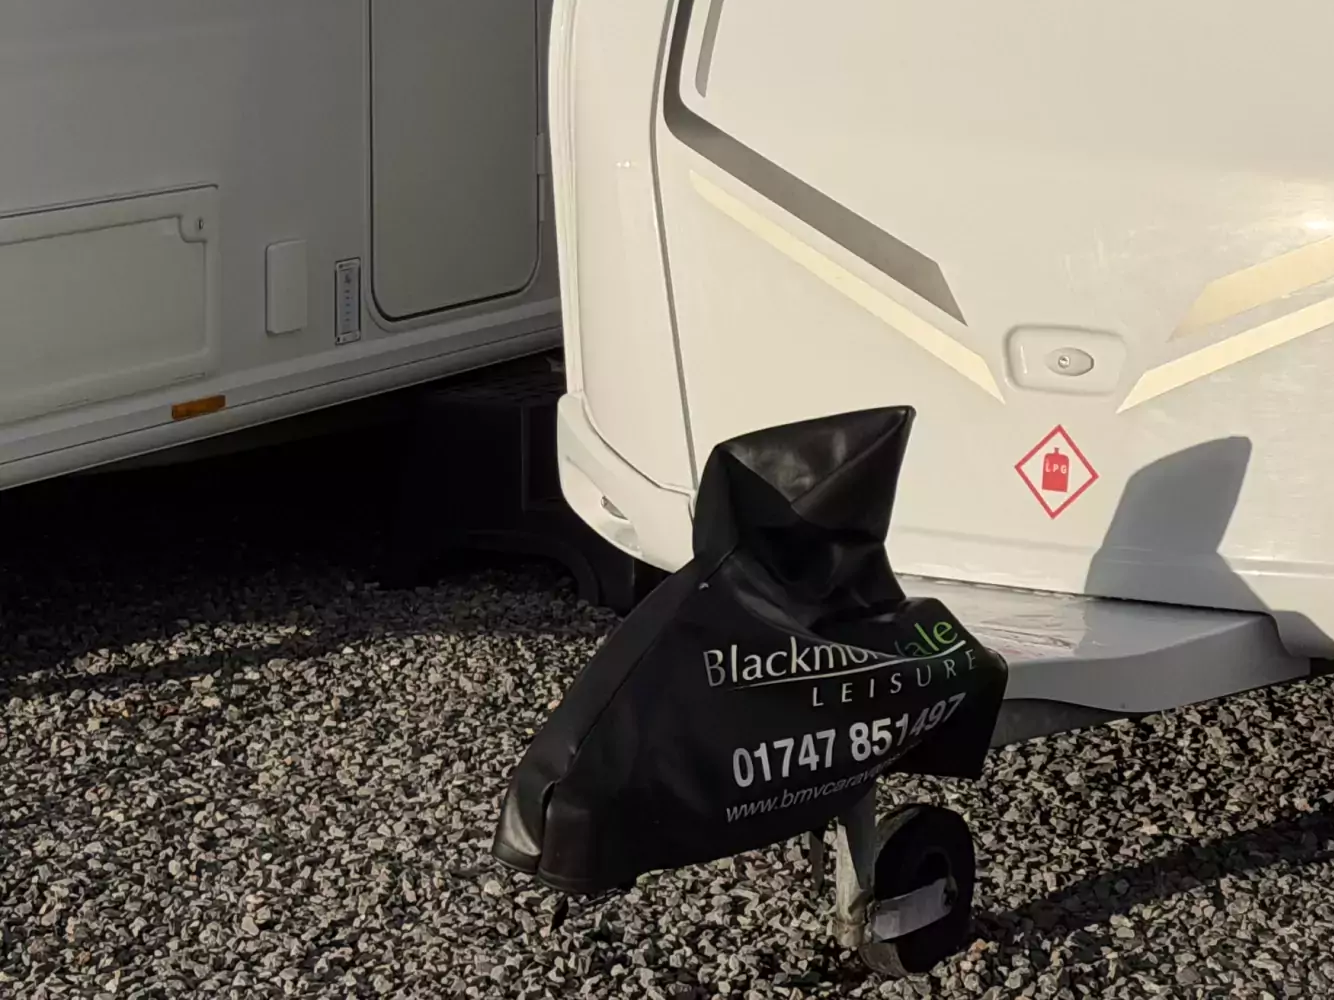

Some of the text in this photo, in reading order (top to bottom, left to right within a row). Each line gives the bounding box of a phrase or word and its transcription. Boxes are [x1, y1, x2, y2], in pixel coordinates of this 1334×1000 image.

[1044, 460, 1068, 475] LPG
[811, 648, 978, 707] LEISURE
[732, 691, 967, 788] 01747 851497
